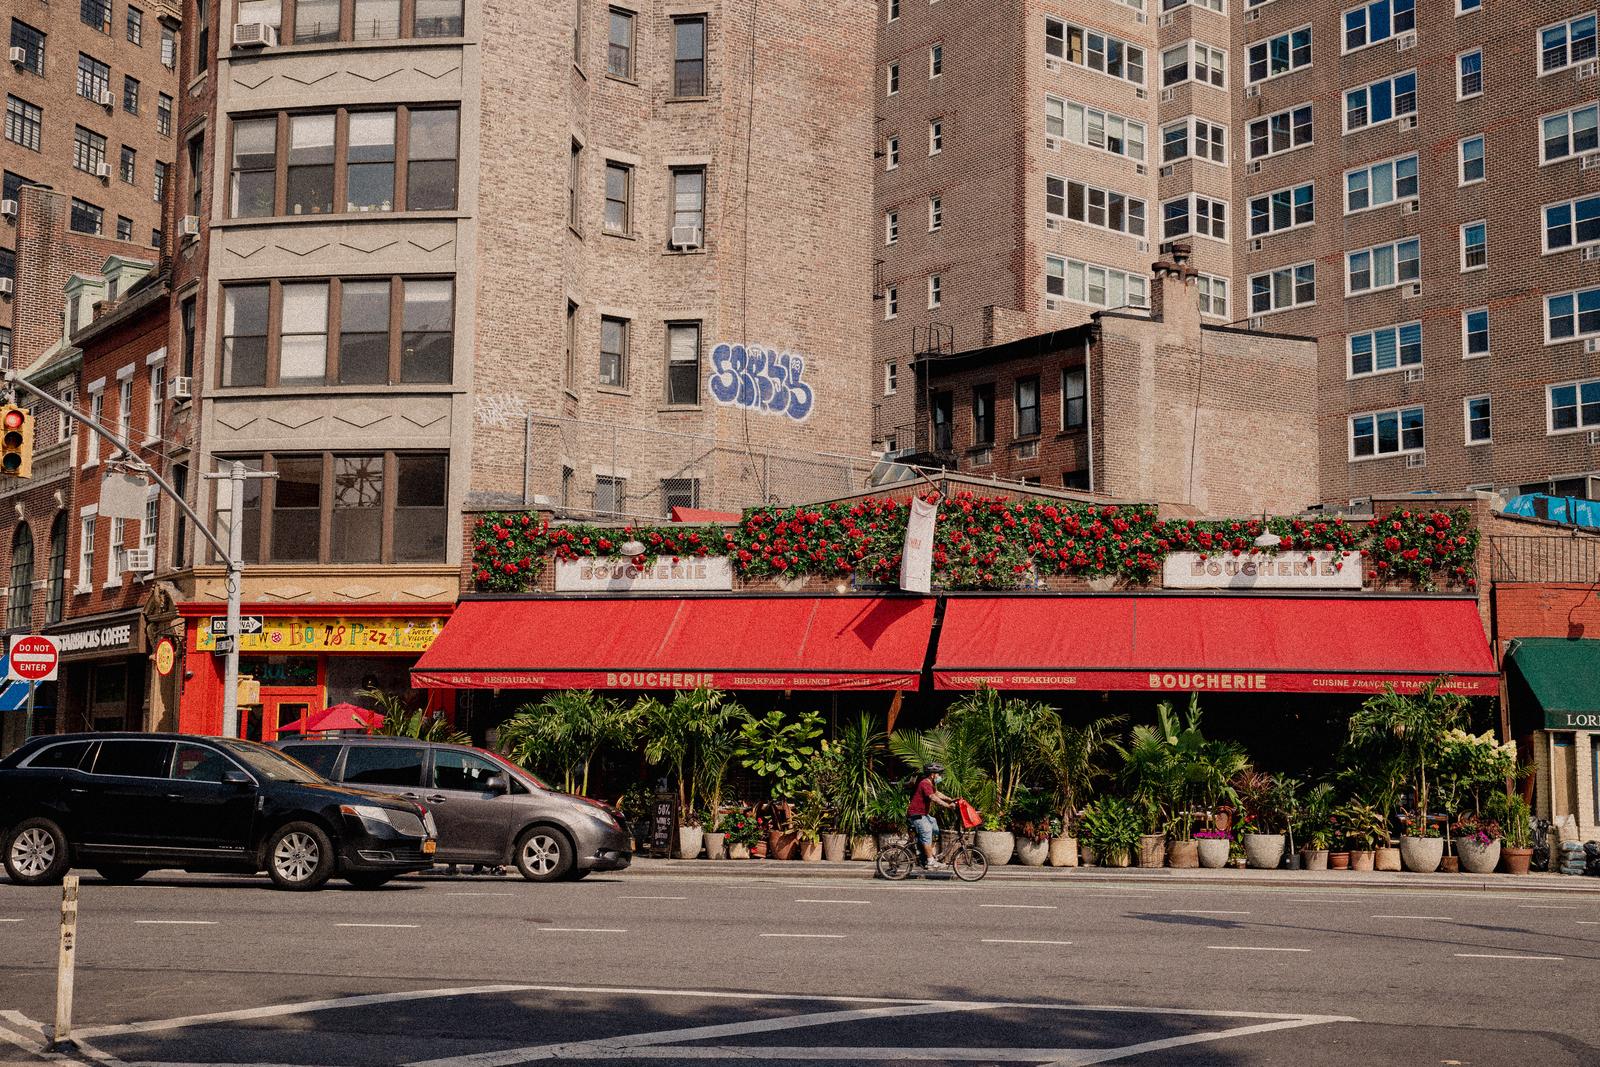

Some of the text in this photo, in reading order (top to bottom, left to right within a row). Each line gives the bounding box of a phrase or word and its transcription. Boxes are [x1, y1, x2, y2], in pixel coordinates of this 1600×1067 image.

[1190, 561, 1336, 577] BOUCHERIE
[101, 624, 131, 647] COFFEE
[19, 644, 50, 652] DO NOT
[20, 663, 47, 671] ENTER
[452, 676, 472, 684] BAR
[484, 676, 546, 684] RESTAURANT
[606, 672, 714, 687] BOUCHERIE
[734, 677, 786, 685] BREAKFAST
[793, 677, 831, 685] BRUNCH
[1011, 676, 1077, 684] STEAKHOUSE
[1149, 673, 1267, 689] BOUCHERIE
[1312, 678, 1350, 687] CUISINE
[1567, 714, 1600, 727] LOR
